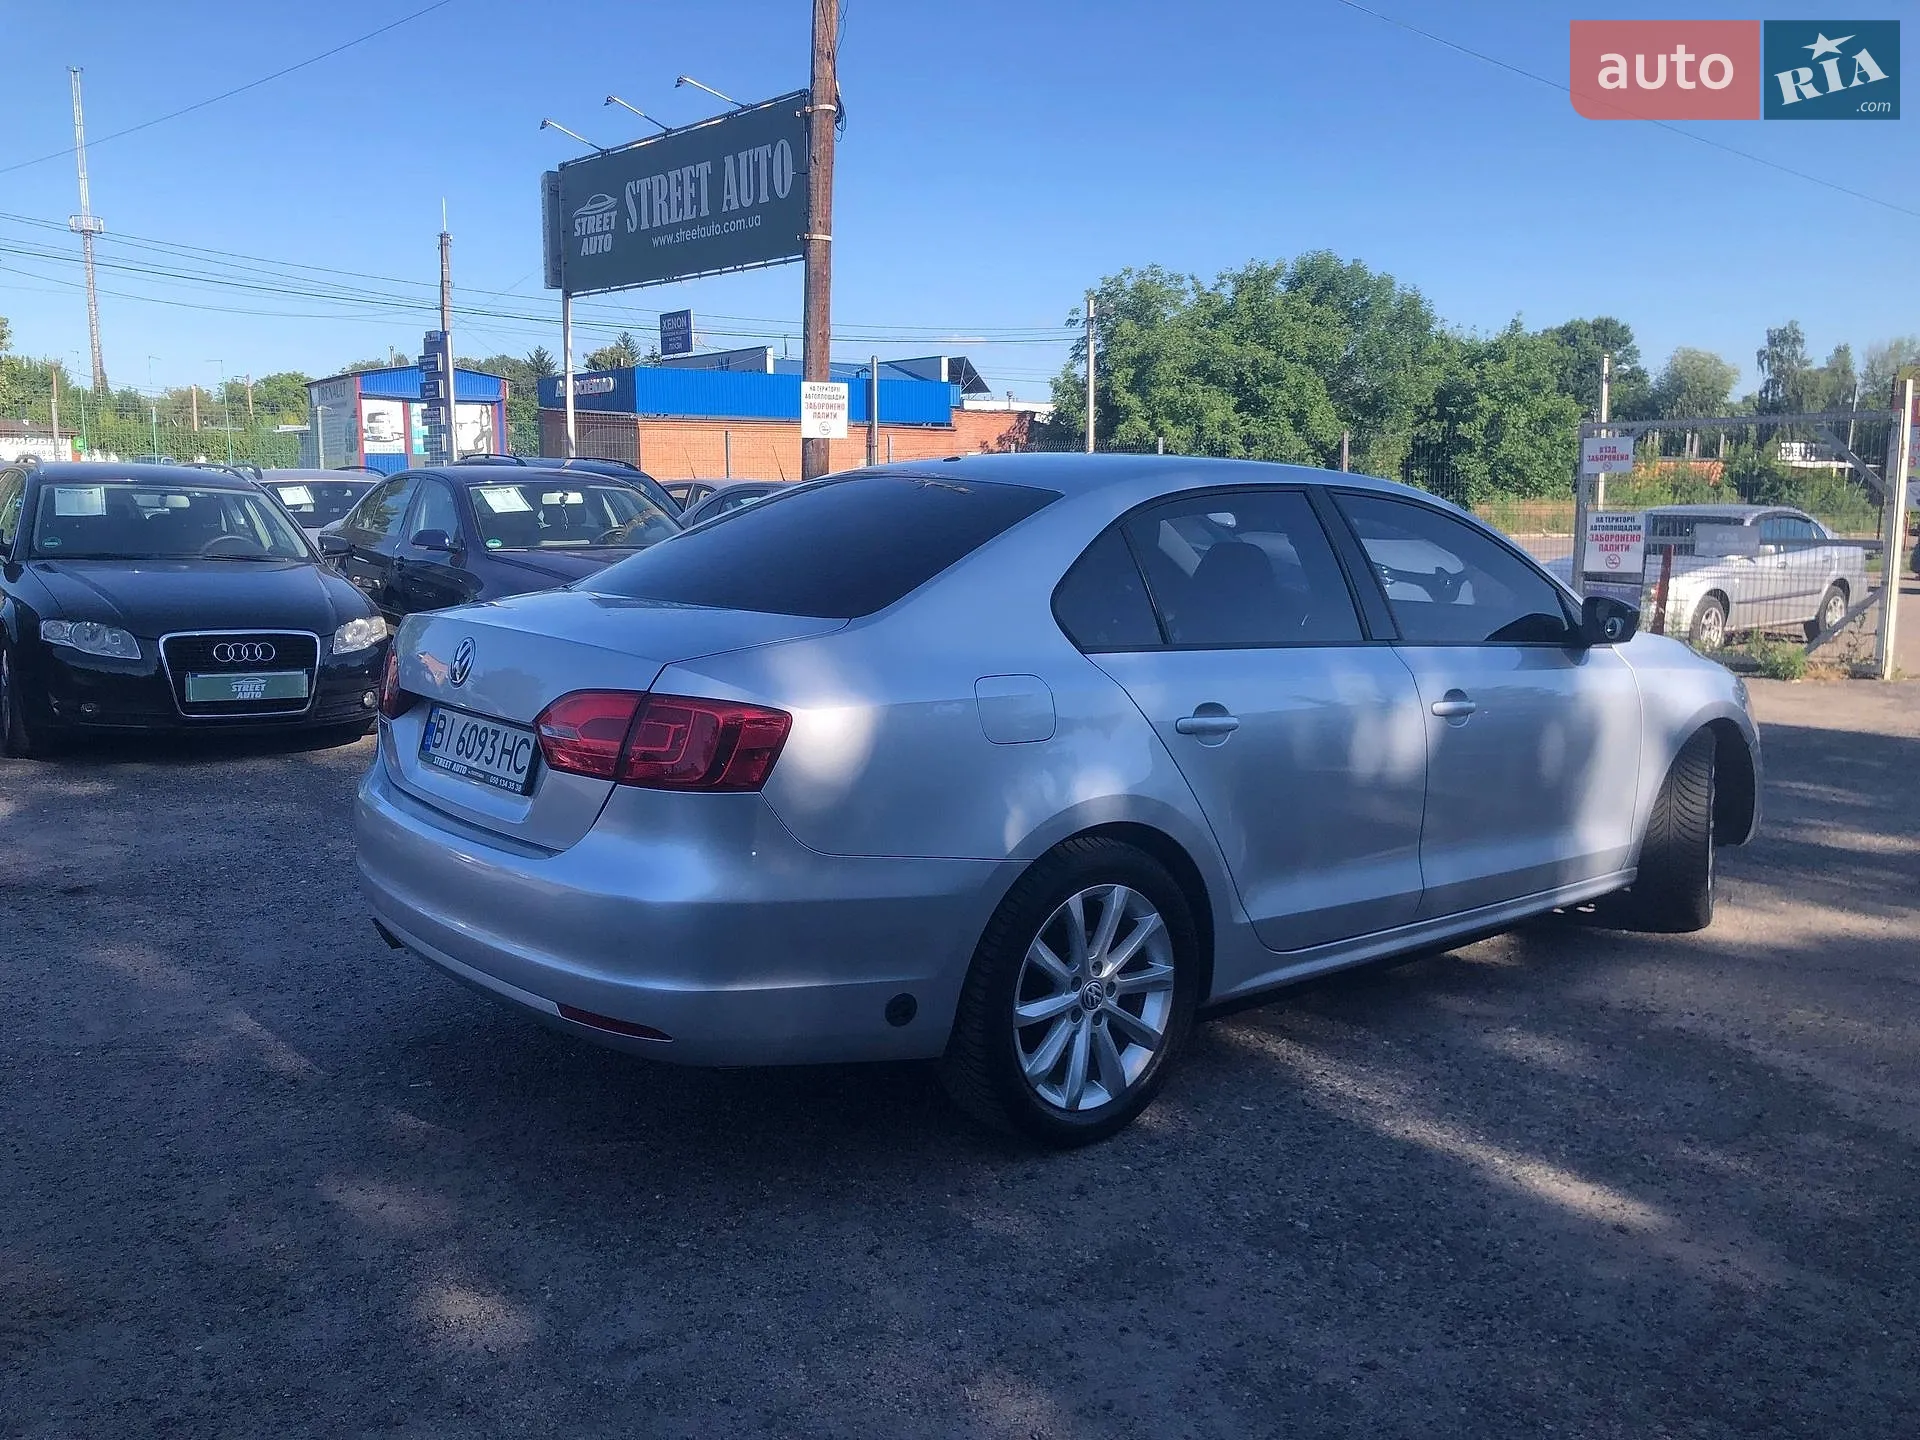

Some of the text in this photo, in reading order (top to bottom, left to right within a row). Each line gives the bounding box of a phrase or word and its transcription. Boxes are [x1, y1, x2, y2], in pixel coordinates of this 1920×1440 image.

[625, 138, 794, 233] STREET AUTO
[573, 210, 617, 237] STREET
[651, 214, 761, 248] www.streetauto.com.ua
[580, 233, 613, 257] AUTO
[662, 315, 687, 331] XENON
[805, 402, 845, 410] ЗАБОРОНЕНО
[1589, 533, 1641, 543] ЗАБОРОНЕНО
[1598, 544, 1630, 552] ПАЛИТИ
[231, 683, 266, 692] STREET
[236, 691, 262, 699] AUTO
[433, 757, 452, 770] STREET
[452, 763, 467, 775] AUTO
